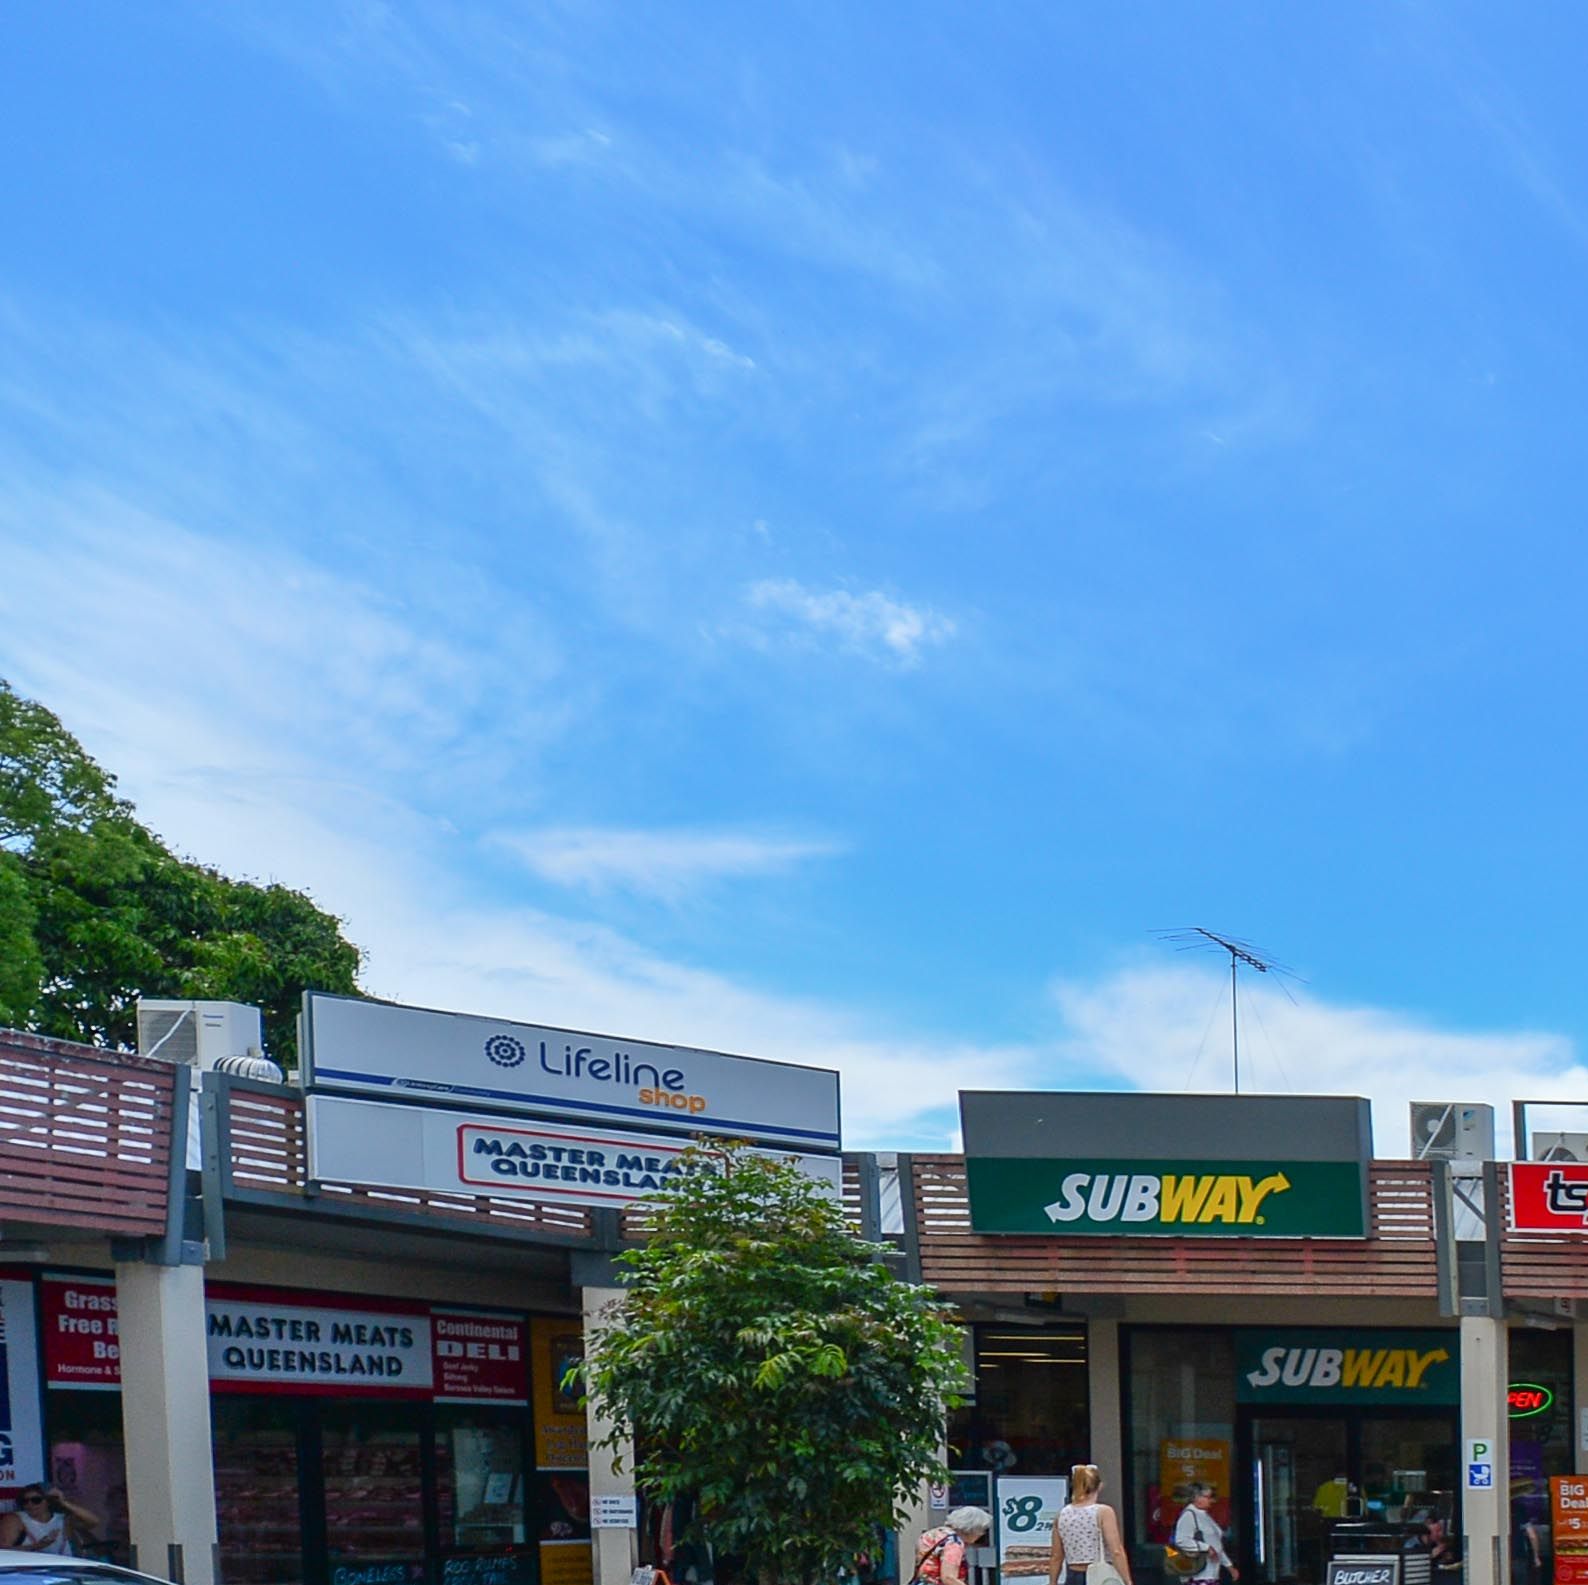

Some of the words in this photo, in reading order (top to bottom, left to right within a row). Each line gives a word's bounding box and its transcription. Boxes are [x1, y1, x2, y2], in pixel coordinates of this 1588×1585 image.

[539, 1041, 685, 1090] Lifeline
[637, 1086, 708, 1114] shop
[473, 1138, 606, 1168] MASTER
[490, 1158, 691, 1193] QUEENSLAN
[1044, 1172, 1291, 1223] SUBWAY
[58, 1315, 103, 1334] Free
[209, 1313, 321, 1343] MASTER
[331, 1322, 414, 1349] MEATS
[436, 1319, 518, 1341] Continental
[222, 1346, 403, 1377] QUEENSLAND
[436, 1340, 520, 1361] DELI
[57, 1363, 103, 1376] Hormone
[1247, 1347, 1449, 1389] SUBWAY
[1507, 1391, 1543, 1409] PEN
[1167, 1447, 1191, 1459] BIG
[1193, 1447, 1222, 1459] Deal
[1473, 1443, 1487, 1461] P
[1560, 1483, 1585, 1496] BIG
[1002, 1495, 1043, 1532] $8
[1333, 1569, 1391, 1585] BUTCHER
